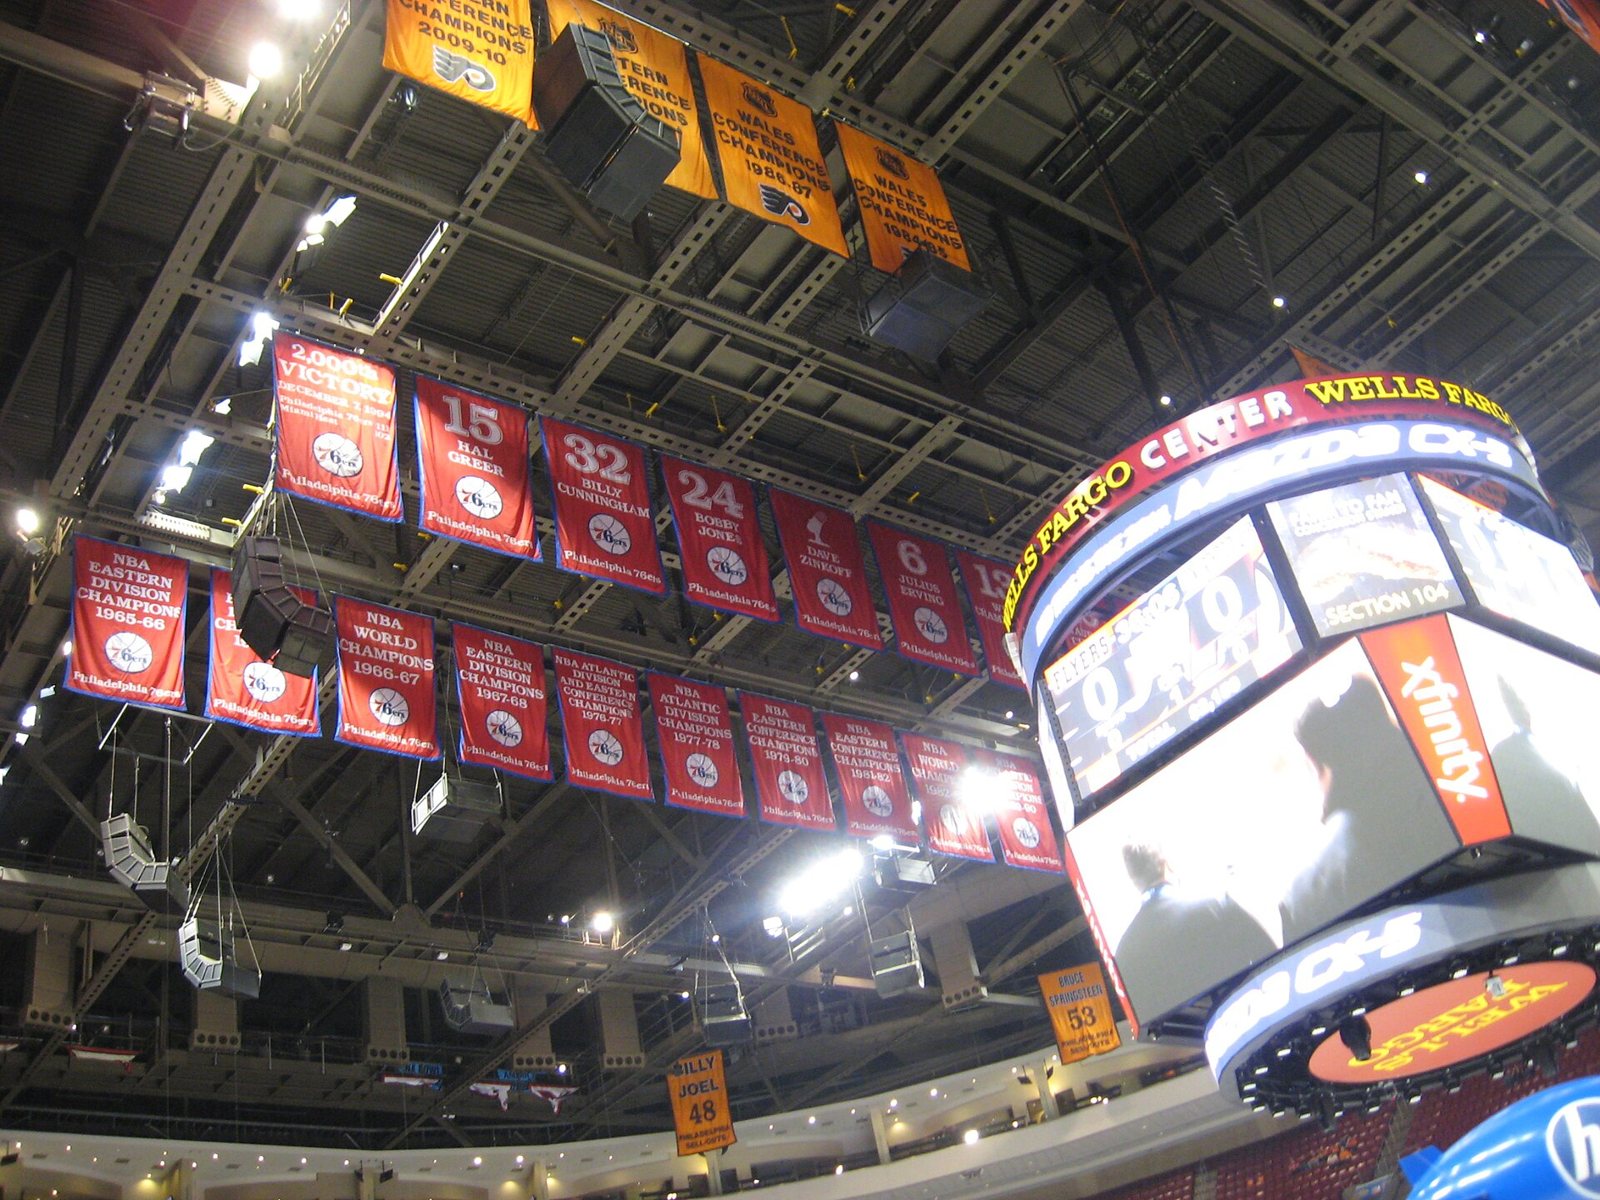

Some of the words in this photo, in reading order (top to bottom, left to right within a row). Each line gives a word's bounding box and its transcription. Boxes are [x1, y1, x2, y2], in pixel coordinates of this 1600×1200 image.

[400, 0, 526, 54] CHAMPIONS
[440, 0, 532, 39] ERENCE
[418, 20, 507, 66] 2009-10
[617, 57, 669, 86] TERN
[737, 109, 795, 146] WALES
[713, 112, 827, 177] CONFERENCE
[718, 129, 831, 192] CHAMPIONS
[874, 174, 927, 208] WALES
[854, 178, 958, 233] CONFERENCE
[861, 196, 962, 249] CHAMPIONS
[279, 358, 392, 405] VICTORY
[1305, 376, 1441, 405] WELLS
[278, 380, 349, 408] DECEMBER
[443, 395, 504, 445] 15
[457, 439, 493, 460] HAL
[563, 433, 631, 485] 32
[447, 451, 504, 478] GREER
[282, 467, 360, 499] Philadelphia
[582, 477, 622, 498] BILLY
[678, 469, 744, 519] 24
[557, 481, 650, 519] CUNNINGHAM
[1002, 545, 1038, 633] WELLS
[1036, 461, 1134, 555] FARGO
[1140, 390, 1293, 470] CENTER
[427, 510, 502, 542] Philadelphia
[695, 511, 739, 532] BOBBY
[593, 527, 628, 549] 76ers
[698, 526, 743, 545] JONES
[113, 552, 151, 571] NBA
[563, 549, 632, 577] Philadelphia
[633, 569, 662, 584] 76ers
[800, 554, 852, 578] ZINKOFF
[807, 546, 840, 563] DAVE
[896, 539, 927, 576] 6
[89, 560, 173, 589] EASTERN
[711, 558, 745, 578] 76ers
[90, 575, 171, 603] DIVISION
[688, 582, 751, 606] Philadelphia
[898, 574, 940, 594] JULIUS
[900, 585, 944, 606] ERVING
[1202, 575, 1244, 633] 0
[1325, 592, 1411, 627] SECTION
[1412, 582, 1450, 606] 104
[96, 606, 166, 631] 1965-66
[366, 611, 404, 630] NBA
[802, 613, 857, 636] Philadelphia
[353, 624, 417, 650] WORLD
[484, 638, 515, 656] NBA
[339, 637, 435, 672] CHAMPIONS
[466, 646, 533, 673] EASTERN
[901, 641, 953, 664] Philadelphia
[1053, 634, 1111, 691] FLYERS
[353, 660, 420, 686] 1966-67
[469, 660, 532, 685] DIVISION
[555, 655, 579, 669] NBA
[581, 662, 635, 683] ATLANTIC
[573, 669, 621, 687] DIVISION
[73, 671, 148, 695] Philadelphia
[459, 669, 545, 700] CHAMPIONS
[560, 676, 584, 690] AND
[586, 683, 636, 702] EASTERN
[674, 684, 701, 700] NBA
[1081, 666, 1118, 722] 0
[374, 699, 406, 719] 76ers
[476, 686, 528, 709] 1967-68
[563, 686, 634, 711] CONFERENCE
[568, 697, 634, 719] CHAMPIONS
[659, 693, 721, 715] ATLANTIC
[213, 698, 282, 723] Philadelphia
[581, 710, 622, 726] 1976-77
[665, 705, 719, 726] DIVISION
[764, 704, 790, 718] NBA
[344, 722, 407, 746] Philadelphia
[491, 722, 519, 740] 76ers
[658, 716, 732, 739] CHAMPIONS
[746, 722, 817, 746] CONFERENCE
[752, 713, 806, 734] EASTERN
[846, 723, 871, 736] NBA
[673, 732, 720, 750] 1977-78
[749, 734, 818, 758] CHAMPIONS
[830, 741, 899, 762] CONFERENCE
[834, 732, 888, 750] EASTERN
[922, 741, 948, 756] NBA
[764, 749, 810, 767] 1979-80
[834, 753, 901, 773] CHAMPIONS
[918, 754, 960, 773] WORLD
[572, 766, 625, 787] Philadelphia
[851, 768, 891, 783] 1981-82
[671, 788, 722, 806] Philadelphia
[1295, 911, 1422, 994] CX-5
[1058, 972, 1085, 988] BRUCE
[1049, 984, 1103, 1007] SPRINGSTEEN
[1067, 1006, 1097, 1031] 53
[1374, 981, 1569, 1071] WELLS
[679, 1078, 719, 1098] JOEL
[689, 1100, 717, 1125] 48
